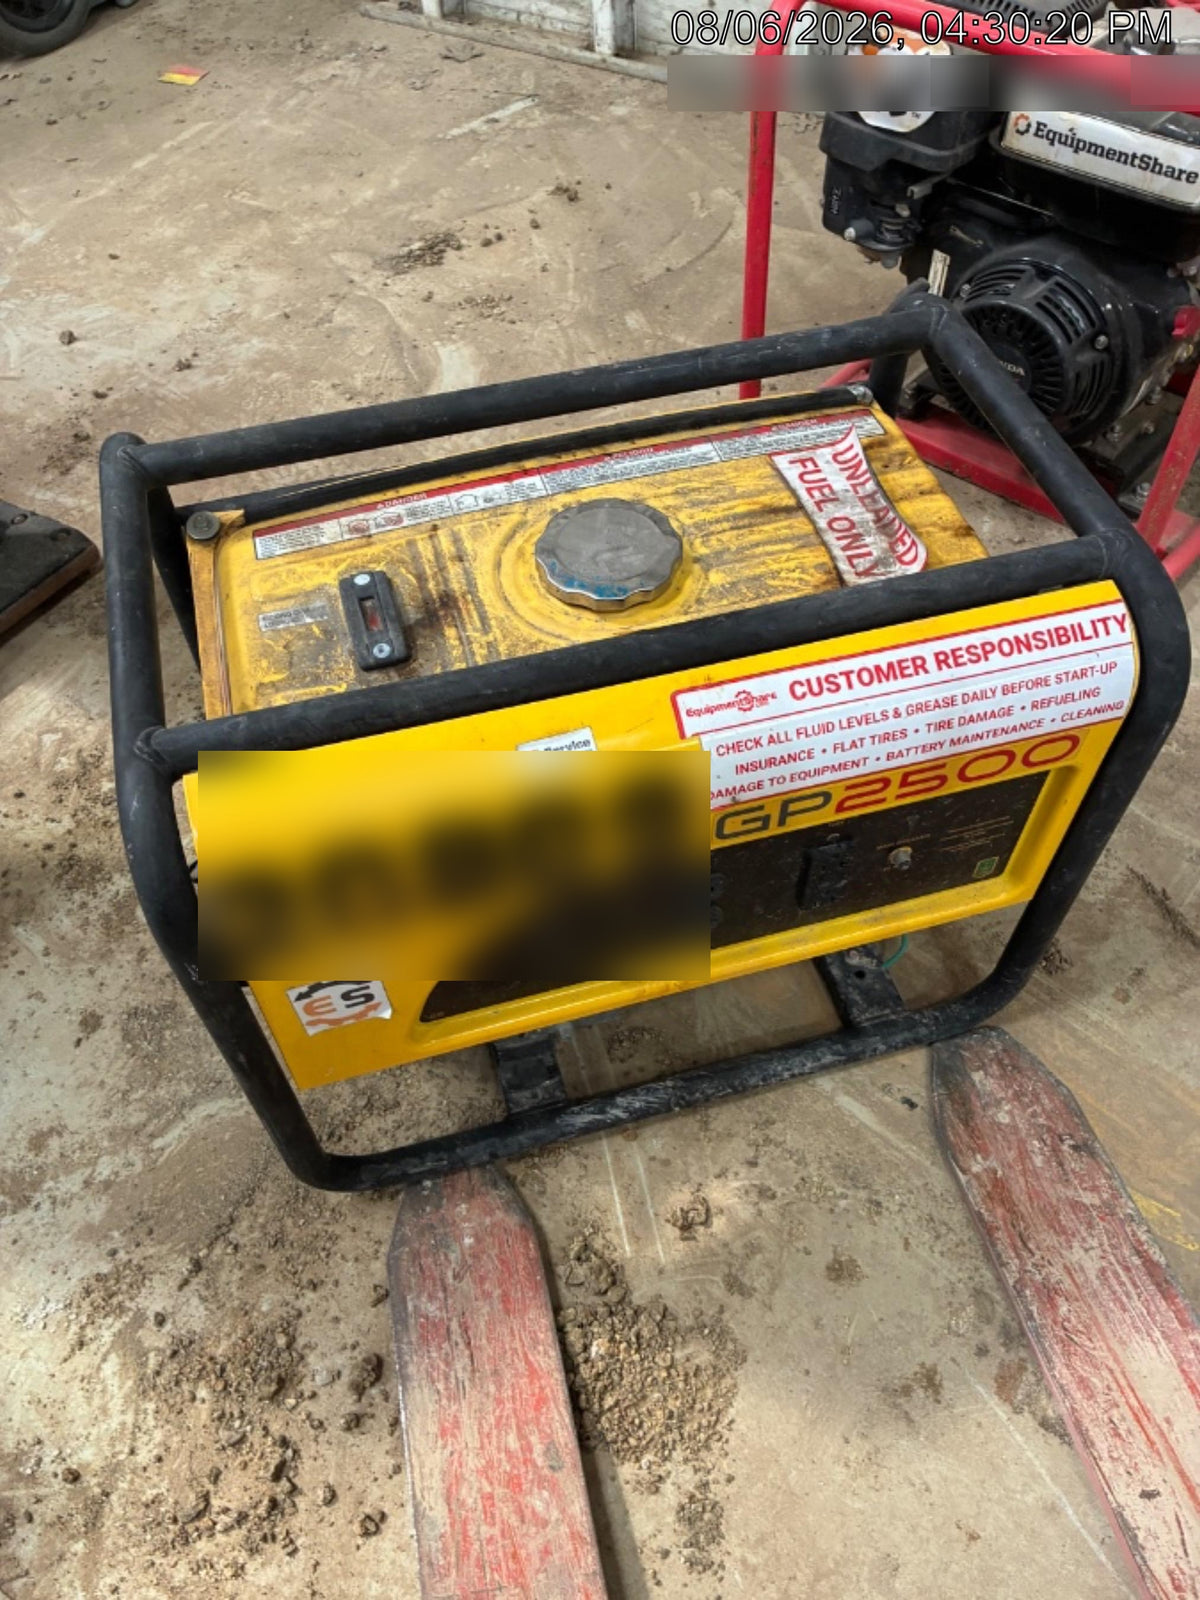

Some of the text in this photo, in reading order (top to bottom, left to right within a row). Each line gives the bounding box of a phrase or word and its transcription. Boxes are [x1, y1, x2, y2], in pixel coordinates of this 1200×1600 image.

[1032, 120, 1199, 184] EquipmentShare
[788, 456, 890, 578] FUEL ONLY
[831, 443, 918, 566] UNLEADED
[789, 612, 1127, 701] CUSTOMER RESPONSIBILITY
[544, 739, 591, 751] rvice
[716, 661, 1118, 757] CHECK ALL FLUID LEVELS & GREASE DAILY BEFORE START-UP
[735, 687, 1101, 776] INSURANCE FLAT TIRES TIRE DAMAGE REFUELING
[769, 775, 787, 788] TO
[789, 757, 870, 783] EQUIPMENT
[886, 740, 947, 761] BATTERY
[949, 719, 1045, 748] MAINTENANCE
[1061, 701, 1124, 722] CLEANING
[714, 733, 1080, 840] GP2500
